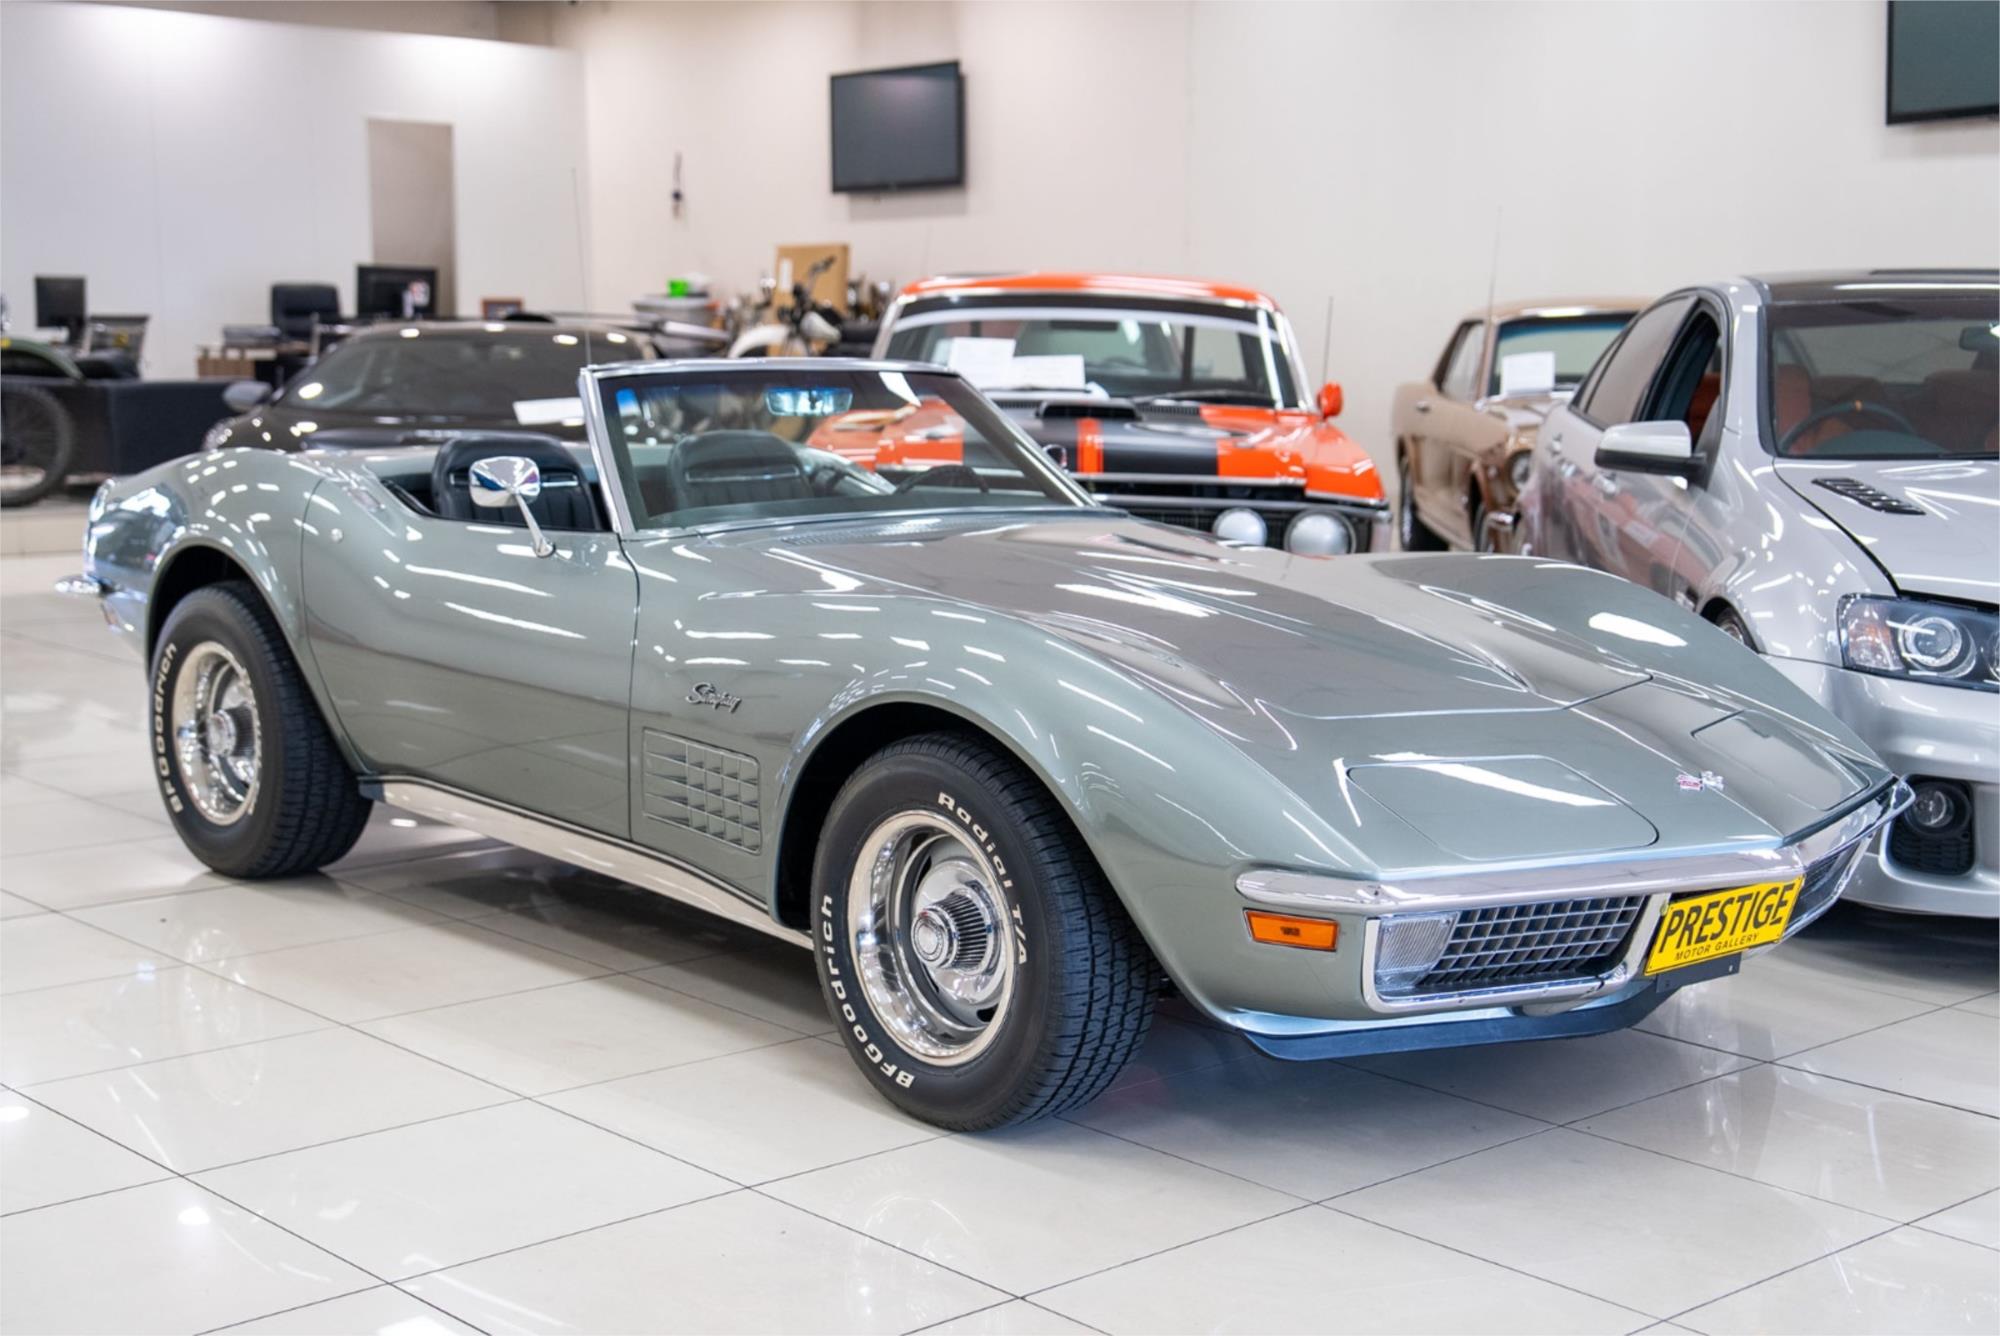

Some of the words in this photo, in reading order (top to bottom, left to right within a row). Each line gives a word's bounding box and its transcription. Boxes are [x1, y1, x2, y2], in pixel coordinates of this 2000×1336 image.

[937, 792, 1013, 888] Radial
[1011, 903, 1027, 965] T/A
[1658, 883, 1796, 953] PRESTIGE
[820, 895, 915, 1088] BFGoodrich
[1673, 943, 1711, 961] MOTOR
[1714, 932, 1760, 951] GALLERY
